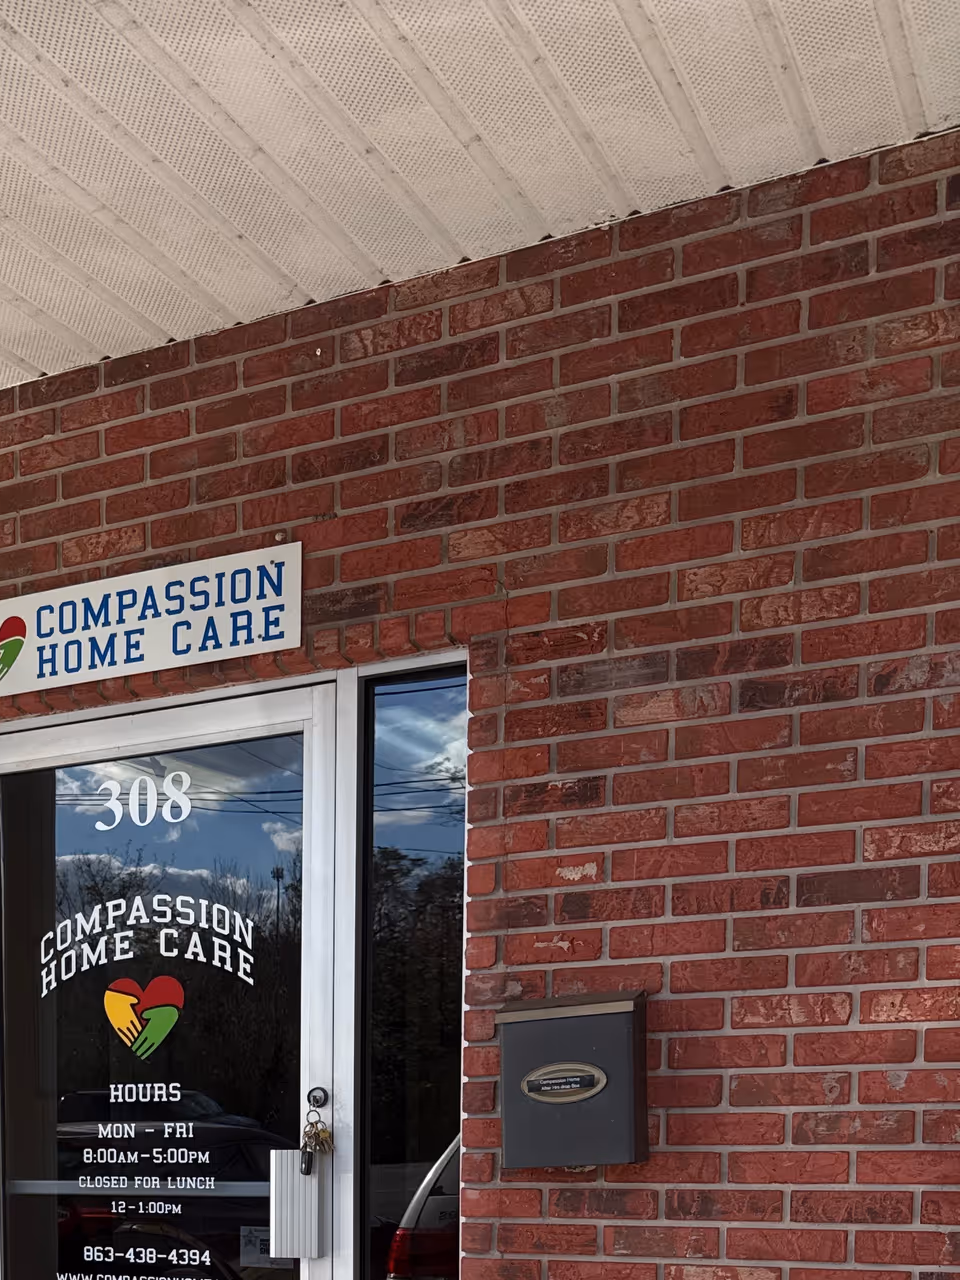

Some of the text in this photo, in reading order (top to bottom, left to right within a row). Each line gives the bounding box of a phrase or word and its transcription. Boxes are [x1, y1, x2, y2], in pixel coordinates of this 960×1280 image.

[36, 561, 286, 639] COMPASSION
[36, 604, 286, 679] HOME CARE
[95, 771, 192, 831] 308
[40, 894, 254, 964] COMPASSION
[40, 928, 254, 998] HOME CARE
[109, 1083, 181, 1102] HOURS
[97, 1123, 136, 1138] MON
[163, 1123, 194, 1138] FRI
[78, 1176, 215, 1190] CLOSED FOR LUNCH
[111, 1201, 182, 1214] 12-1:00PM
[83, 1246, 211, 1266] 863-438-4394
